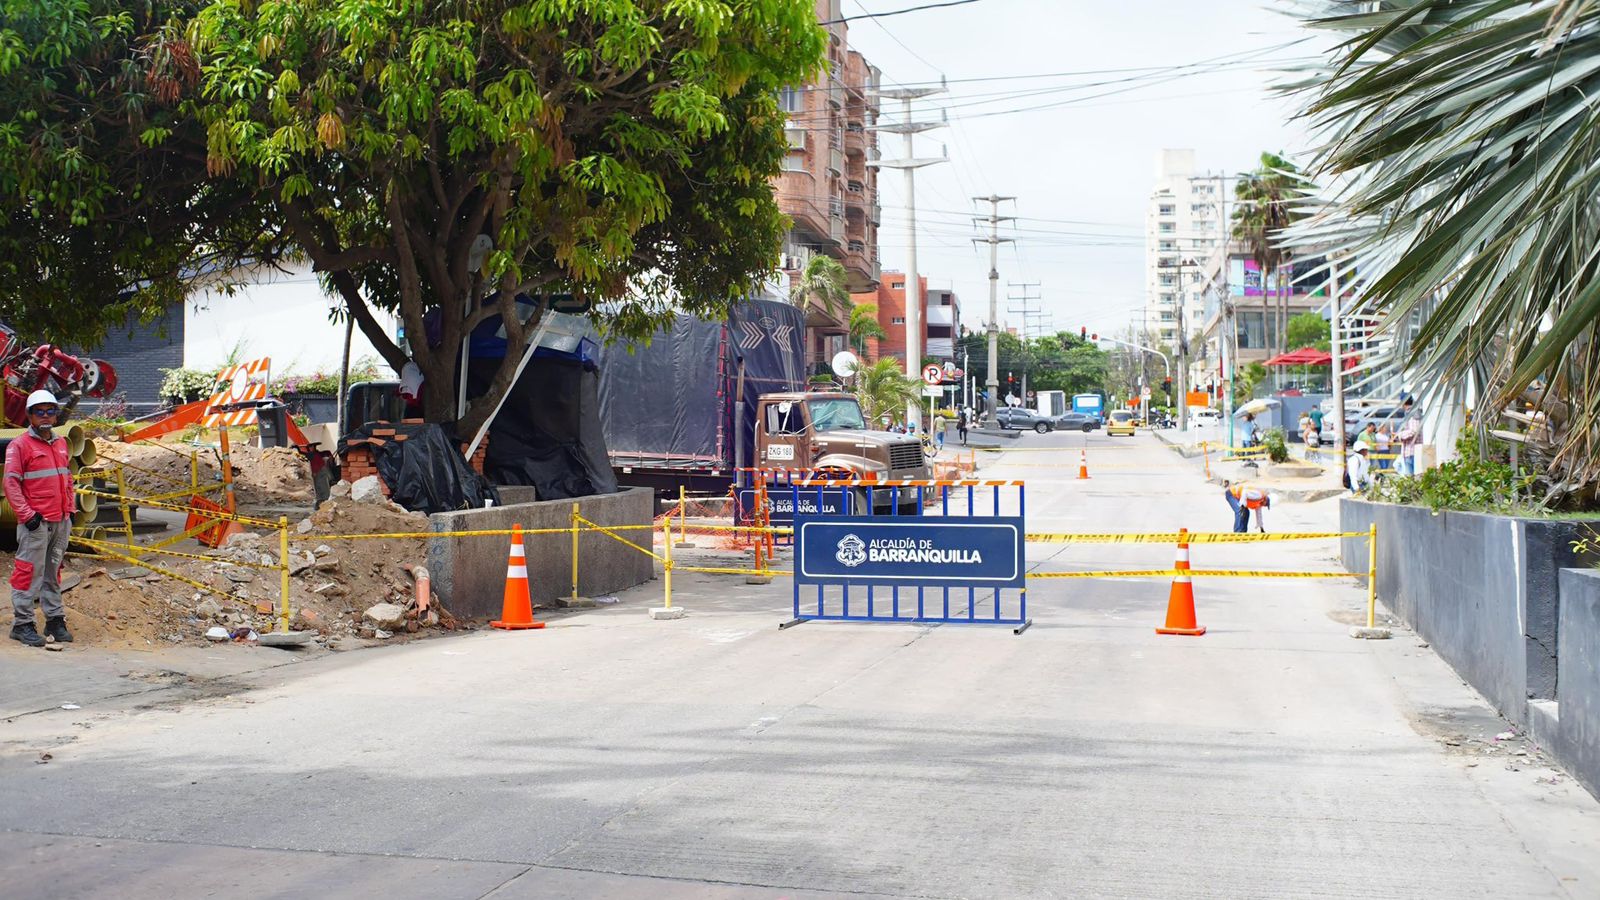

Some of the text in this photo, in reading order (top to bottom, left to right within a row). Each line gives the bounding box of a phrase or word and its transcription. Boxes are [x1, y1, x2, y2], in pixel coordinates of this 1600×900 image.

[929, 368, 938, 380] P
[769, 447, 781, 455] ZKG
[869, 537, 932, 549] ALCALDÍA DE
[869, 549, 982, 563] BARRANQUILLA
